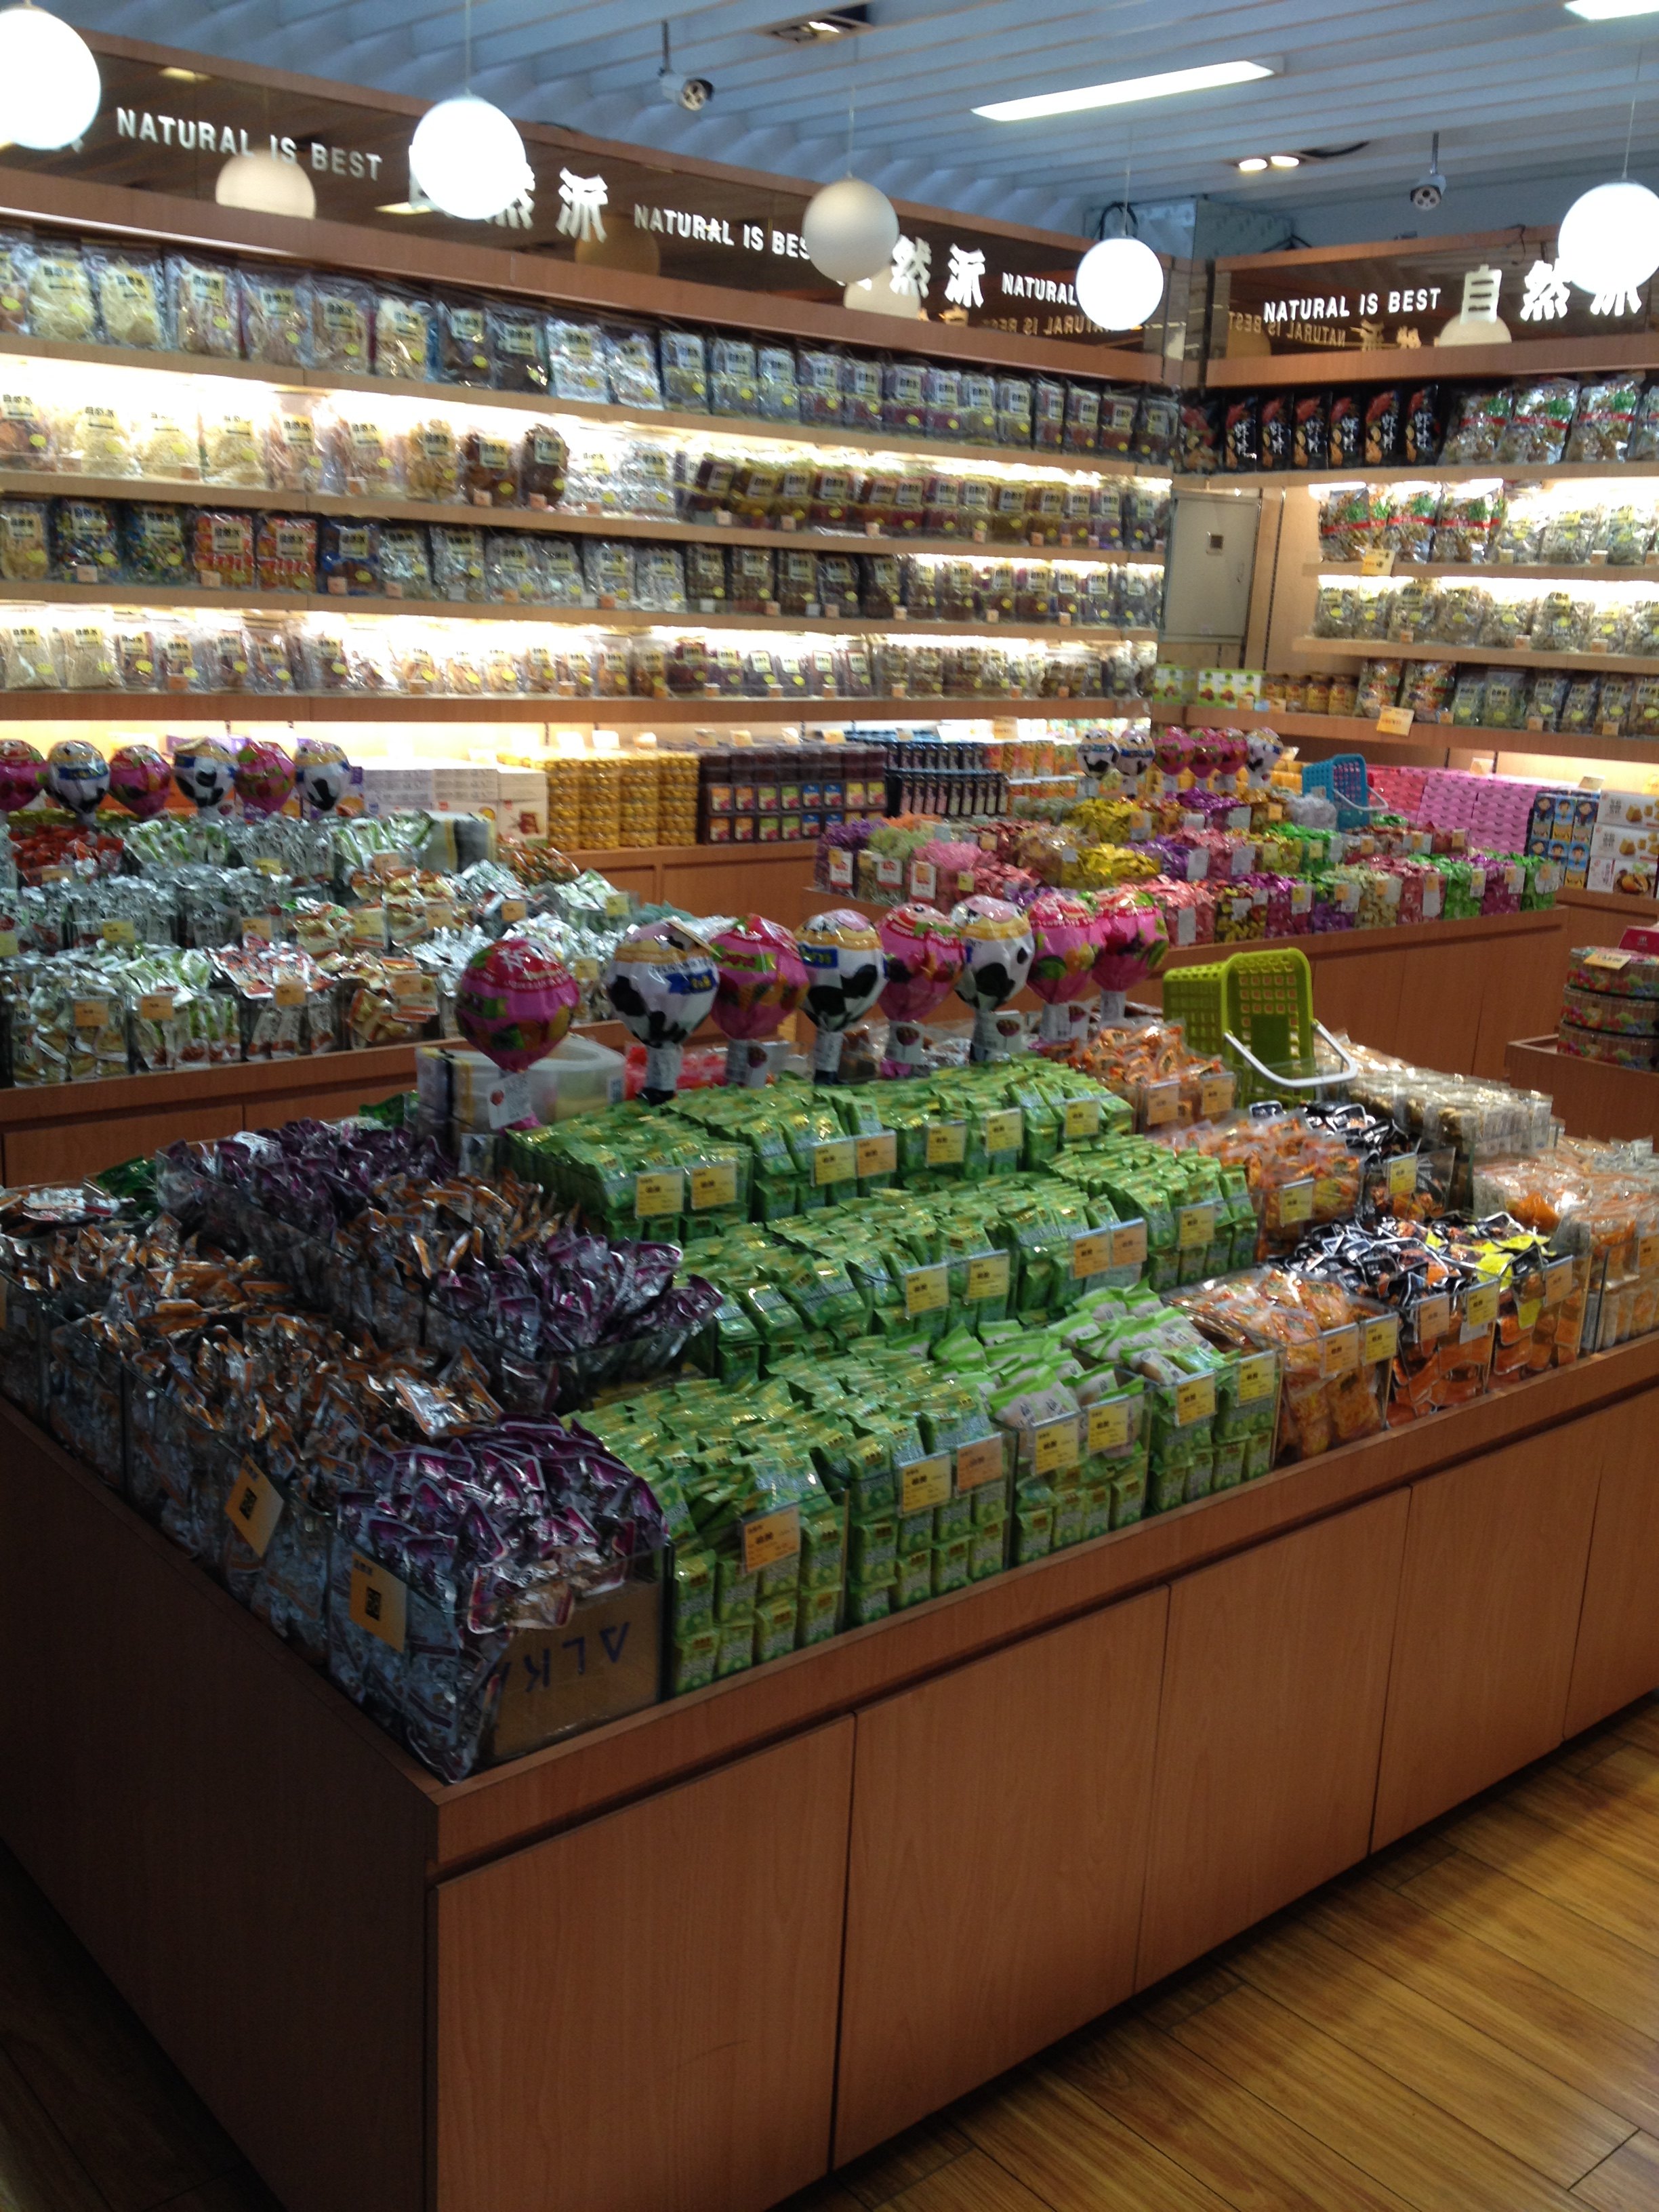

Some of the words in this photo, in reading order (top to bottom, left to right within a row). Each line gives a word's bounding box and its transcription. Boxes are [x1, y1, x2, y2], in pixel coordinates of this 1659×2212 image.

[116, 107, 254, 157] NATURAL
[271, 134, 297, 165] IS
[311, 142, 383, 182] BEST
[634, 203, 736, 247] NATURAL
[743, 224, 765, 251] IS
[772, 230, 811, 260] BES
[1002, 272, 1078, 306] NATURAL
[1263, 295, 1349, 323] NATURAL
[1359, 293, 1378, 315] IS
[1388, 287, 1441, 313] BEST
